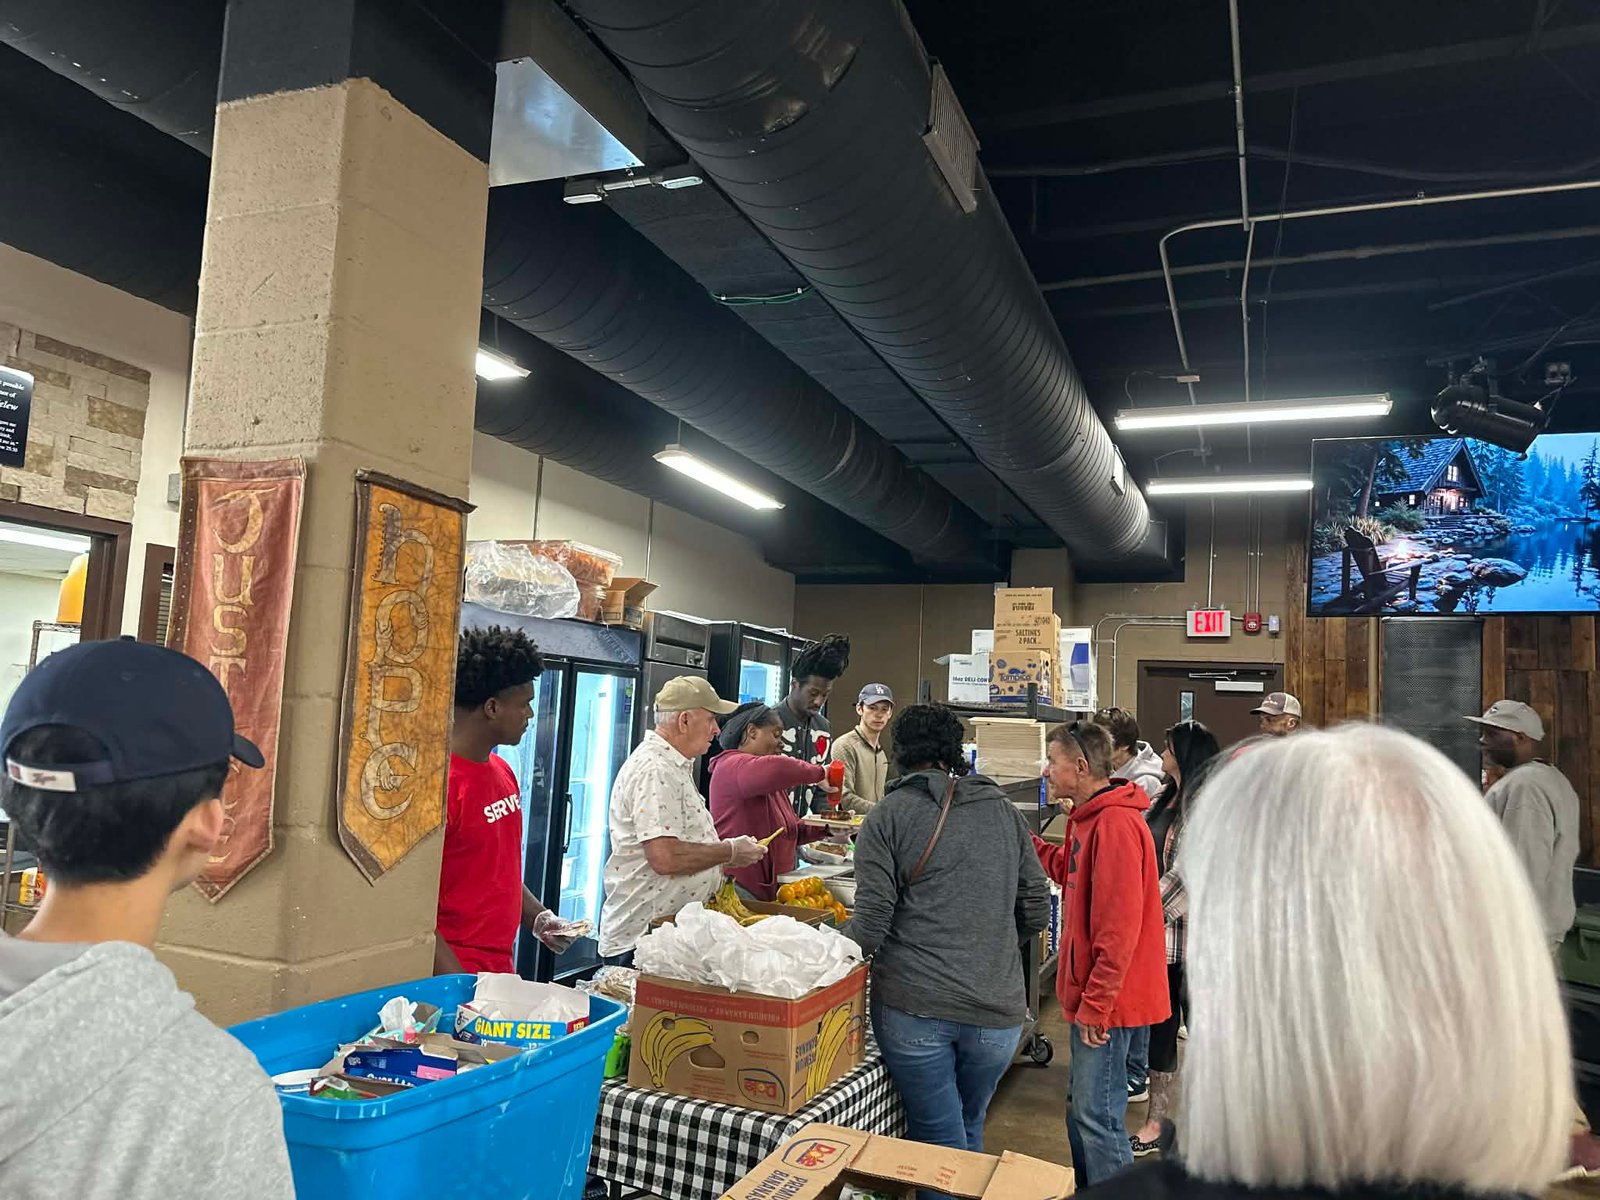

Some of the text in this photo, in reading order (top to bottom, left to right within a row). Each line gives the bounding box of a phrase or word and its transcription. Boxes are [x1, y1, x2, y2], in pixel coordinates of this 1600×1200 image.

[1193, 611, 1225, 633] EXIT
[1015, 629, 1041, 637] SALTINES
[1023, 637, 1037, 645] PACK
[474, 1016, 512, 1038] GIANT
[515, 1022, 551, 1040] SIZE
[744, 1081, 777, 1099] Dole
